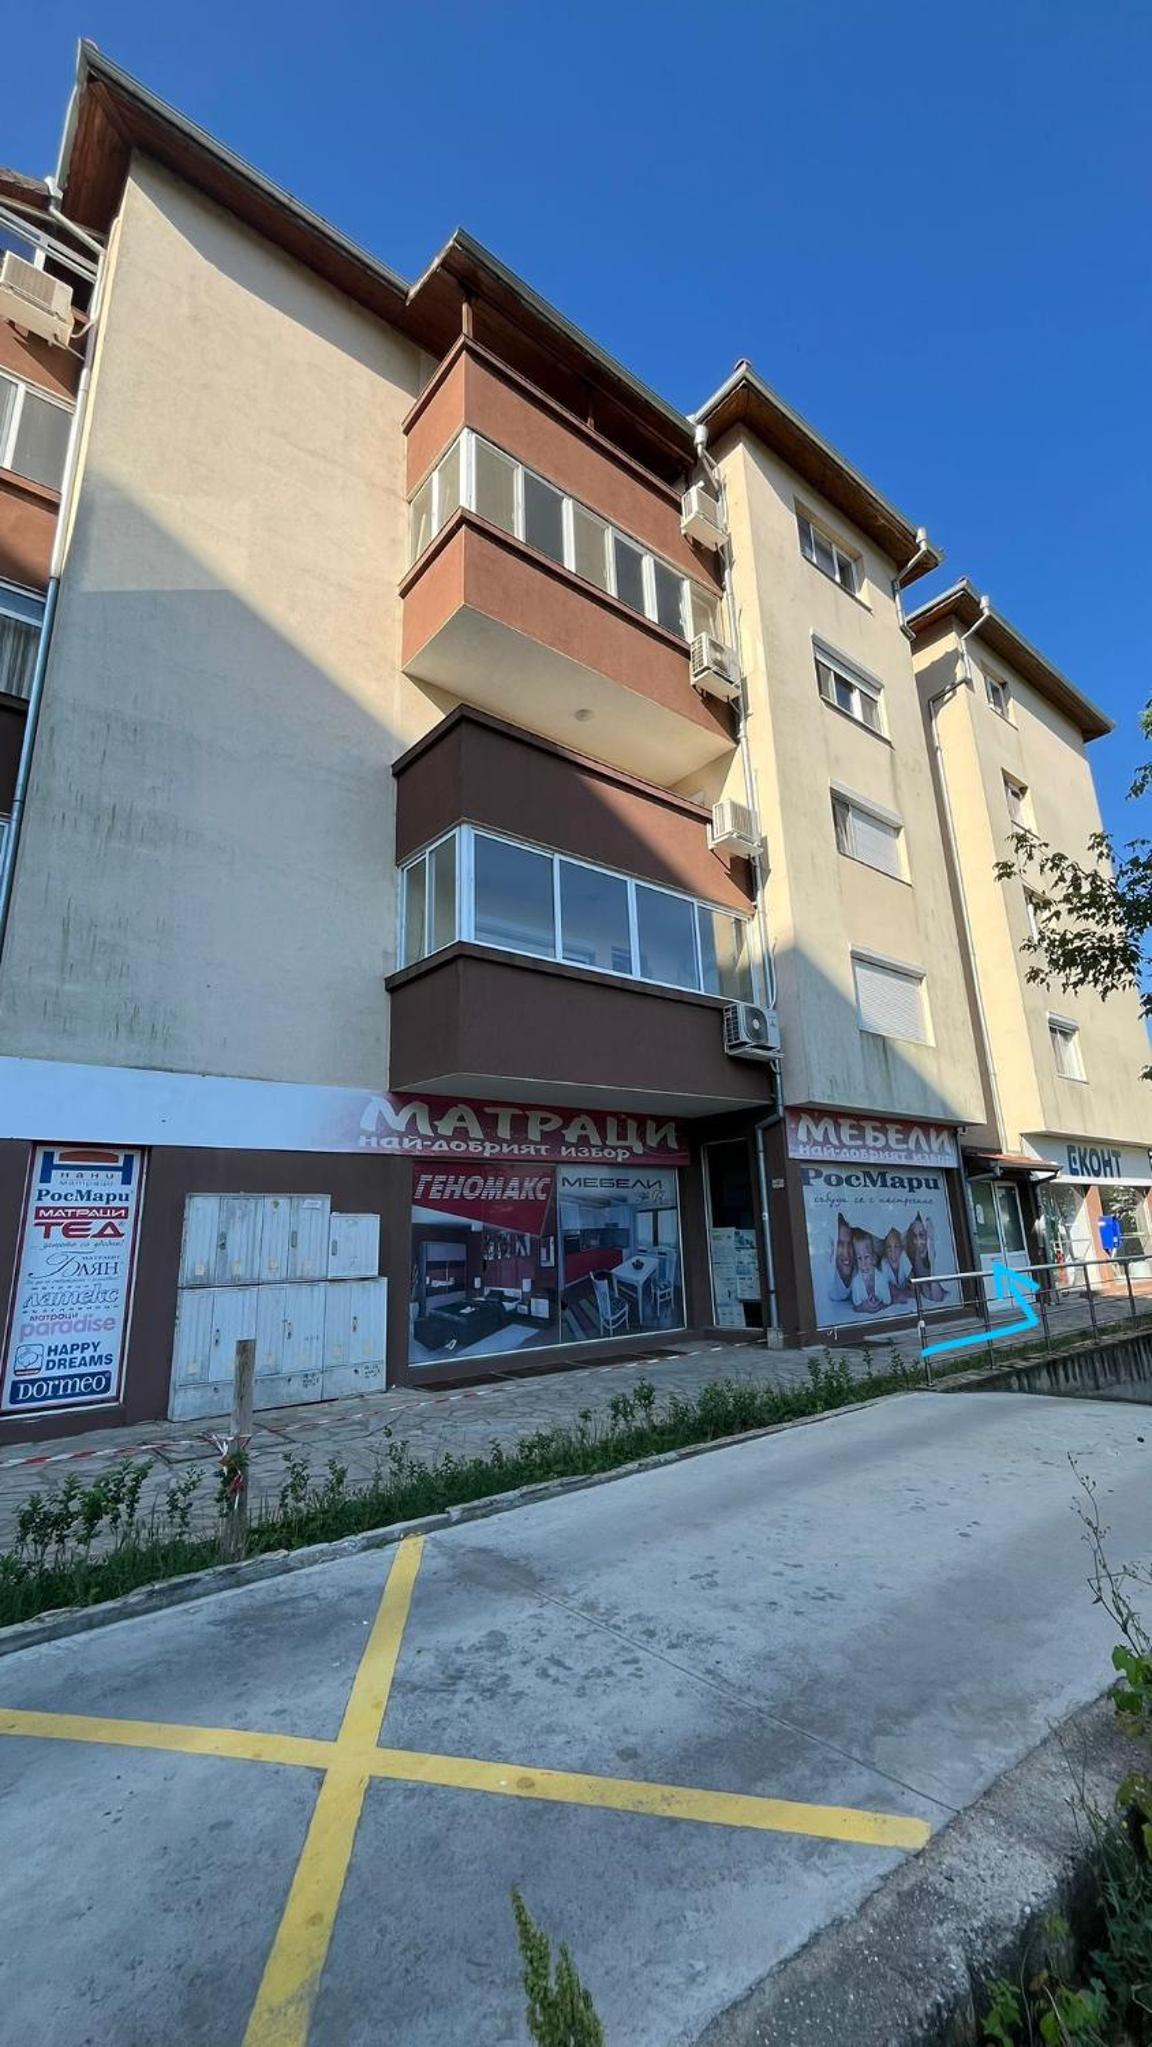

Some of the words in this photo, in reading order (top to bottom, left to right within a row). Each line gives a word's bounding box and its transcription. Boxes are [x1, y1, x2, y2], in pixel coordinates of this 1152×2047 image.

[360, 1096, 679, 1153] МАТРАЦИ
[797, 1113, 952, 1153] МЕБЕЛИ
[1067, 1145, 1121, 1178] ЕКОНТ
[414, 1174, 552, 1200] ГЕНОМАКС
[562, 1177, 662, 1189] МЕБЕЛИ
[801, 1168, 940, 1192] РосМари
[37, 1189, 130, 1204] РосМари
[38, 1208, 127, 1218] МАТРАЦИ
[20, 1313, 116, 1342] paradise
[47, 1341, 101, 1356] HAPPY
[45, 1354, 114, 1371] DREAMS
